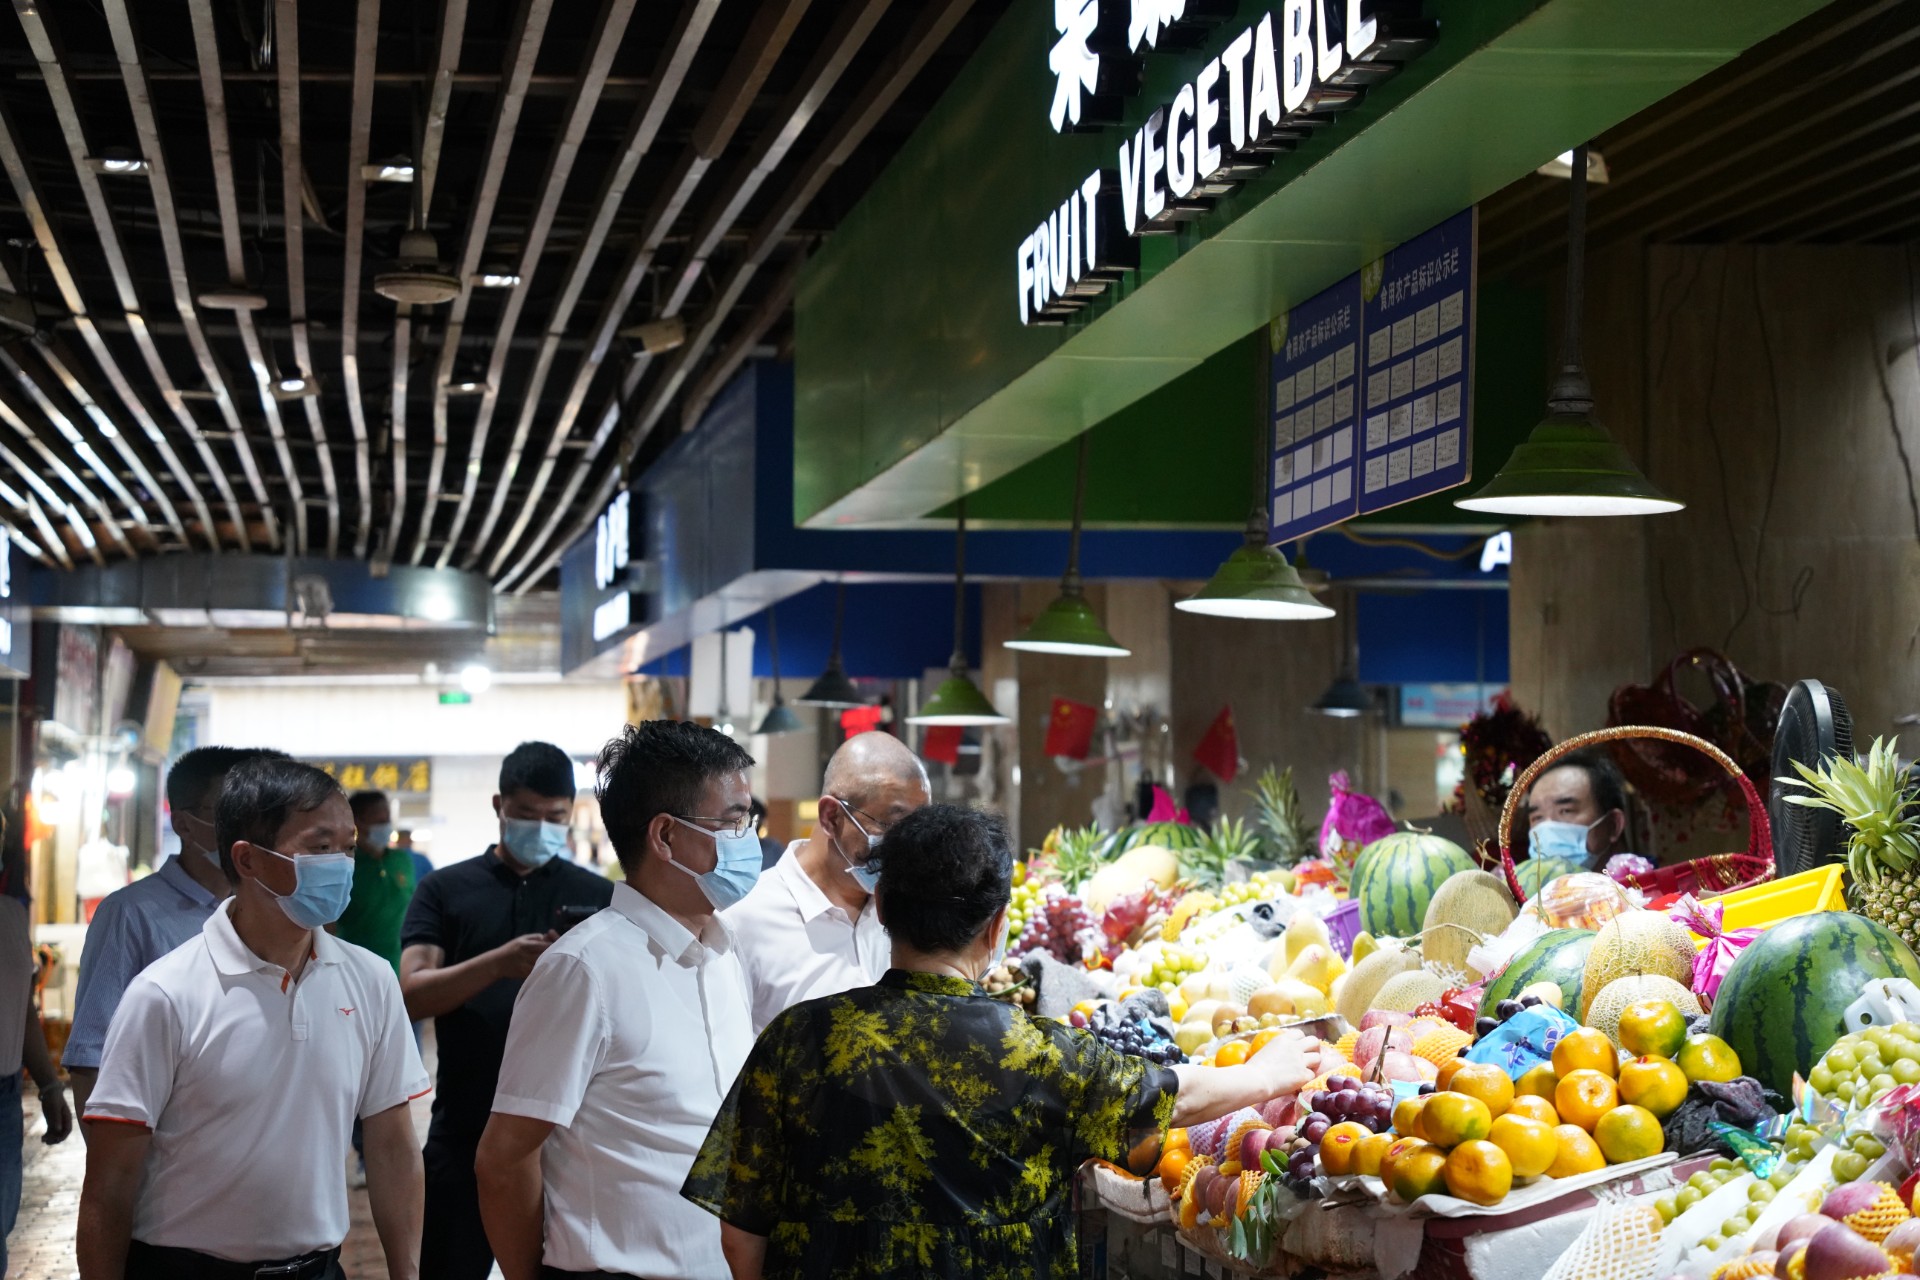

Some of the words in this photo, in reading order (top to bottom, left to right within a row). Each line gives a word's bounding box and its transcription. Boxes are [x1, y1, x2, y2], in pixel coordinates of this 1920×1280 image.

[1018, 169, 1101, 325] FRUIT
[1120, 0, 1377, 235] VEGETABLE
[1380, 247, 1459, 311] 食用农产品标识公示栏
